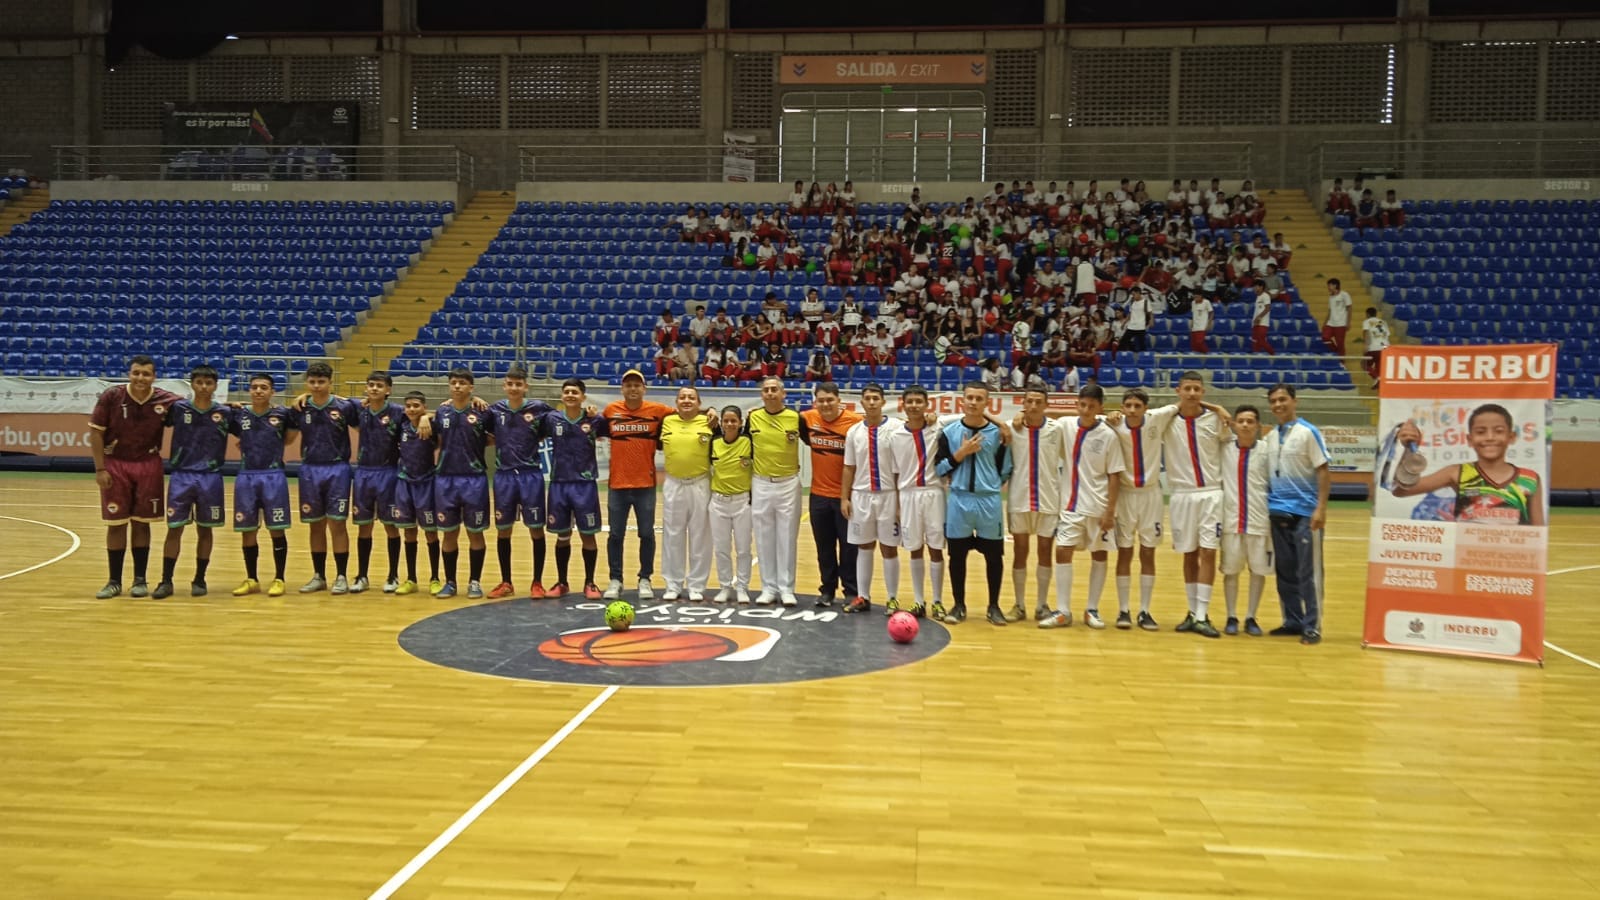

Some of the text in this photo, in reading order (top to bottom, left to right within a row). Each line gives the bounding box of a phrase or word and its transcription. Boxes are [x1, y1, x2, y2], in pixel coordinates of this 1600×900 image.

[836, 62, 897, 77] SALIDA
[910, 63, 941, 77] EXIT
[185, 119, 198, 127] es
[208, 119, 225, 129] por
[1543, 180, 1581, 191] SECTOR
[1385, 354, 1551, 380] INDERBU
[272, 509, 285, 522] 22
[892, 521, 899, 537] 3
[1154, 521, 1162, 537] 5
[1382, 532, 1442, 544] DEPORTIVA
[1380, 549, 1442, 562] JUVENTUD
[1385, 567, 1436, 580] DEPORTE
[1381, 577, 1437, 589] ASOCIADO
[1465, 574, 1534, 588] ESCENARIOS
[1465, 582, 1534, 595] DEPORTIVOS
[1443, 623, 1498, 636] INDERBU
